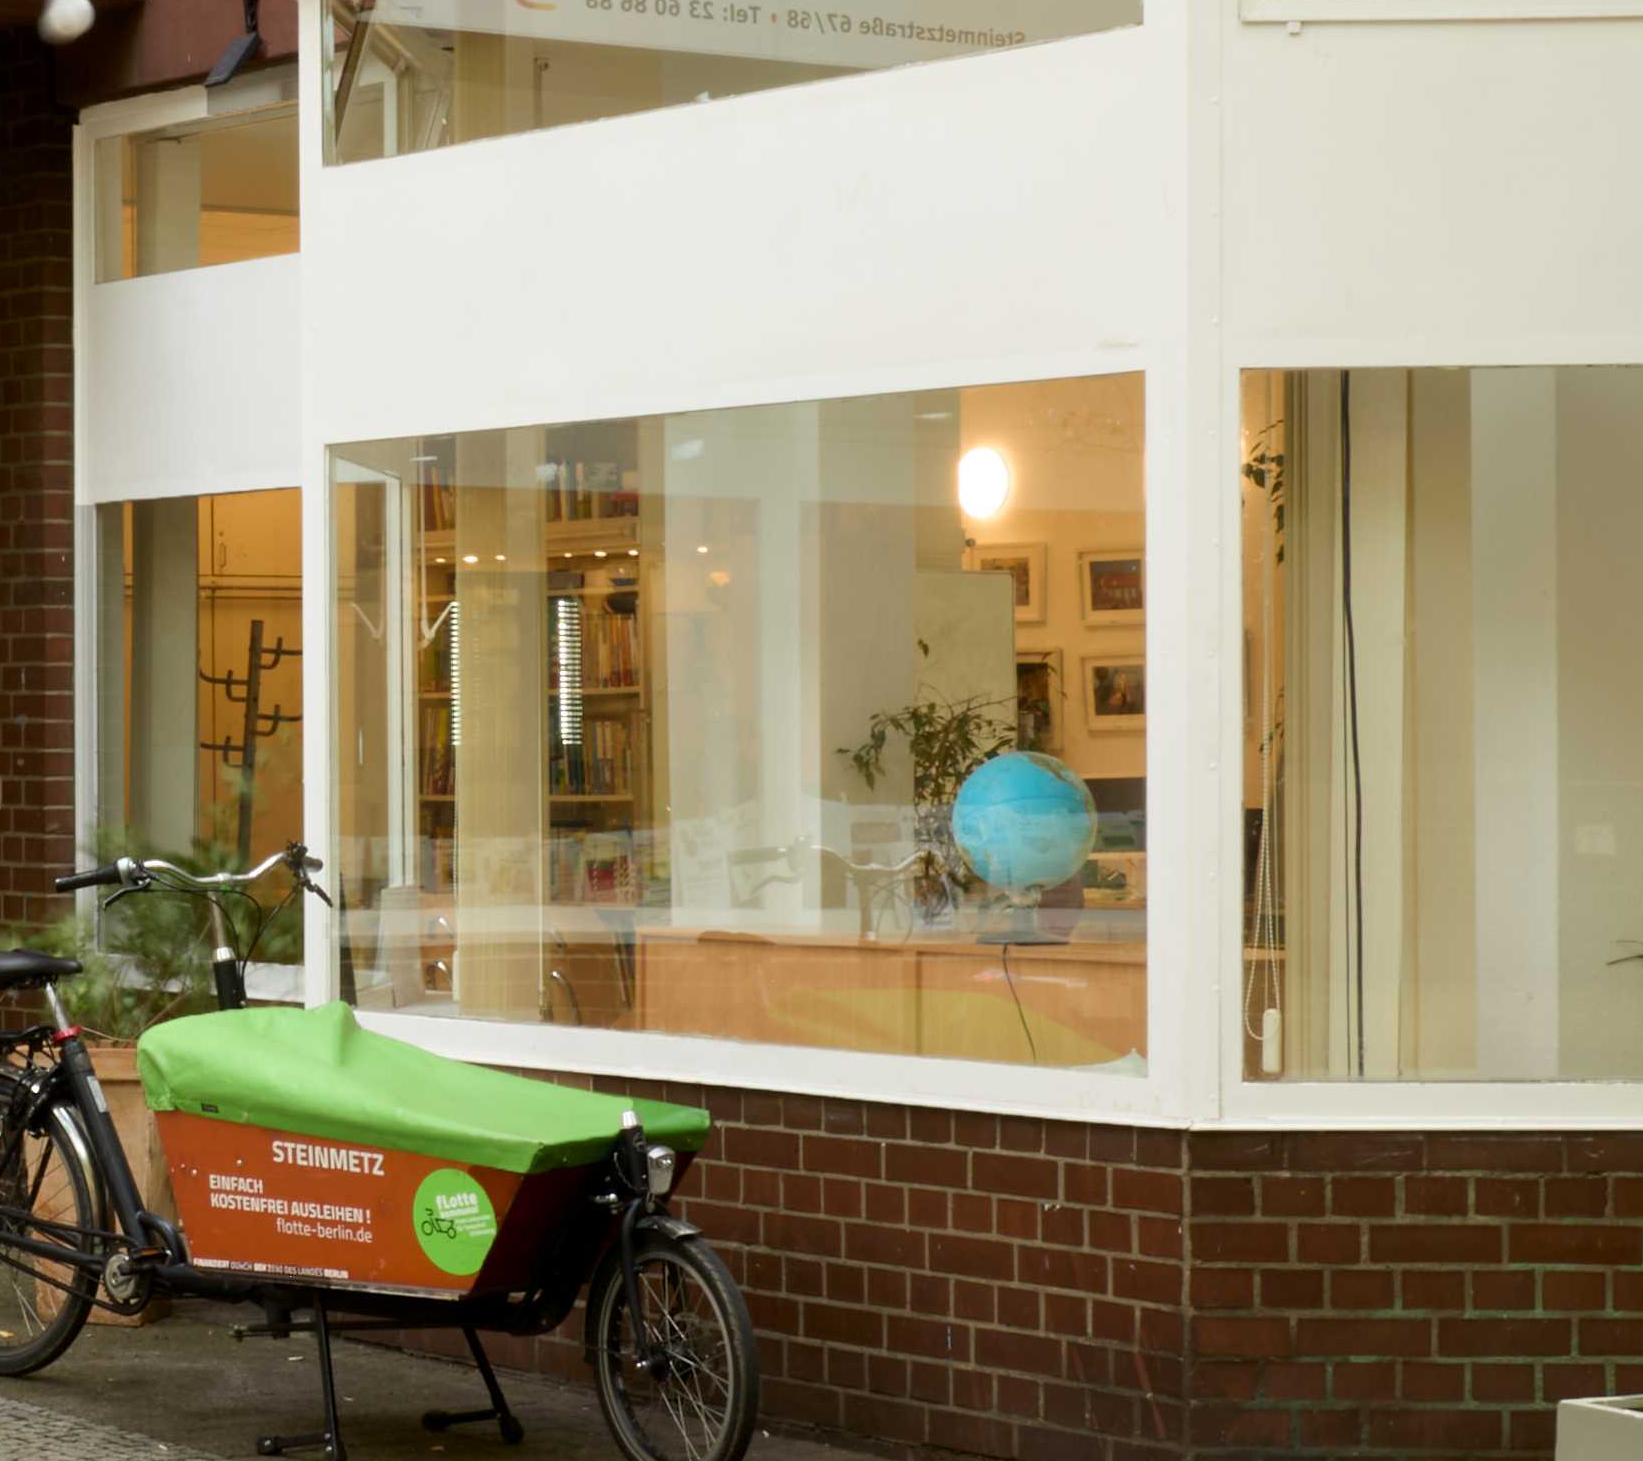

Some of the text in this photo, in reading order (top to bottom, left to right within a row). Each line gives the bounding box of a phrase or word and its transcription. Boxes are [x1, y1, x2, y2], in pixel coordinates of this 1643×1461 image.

[272, 1141, 385, 1176] STEINMETZ
[209, 1174, 263, 1194] EINFACH
[210, 1193, 290, 1215] KOSTENFREI
[291, 1202, 363, 1223] AUSLEIHEN
[276, 1218, 373, 1243] flotte-berlin.de
